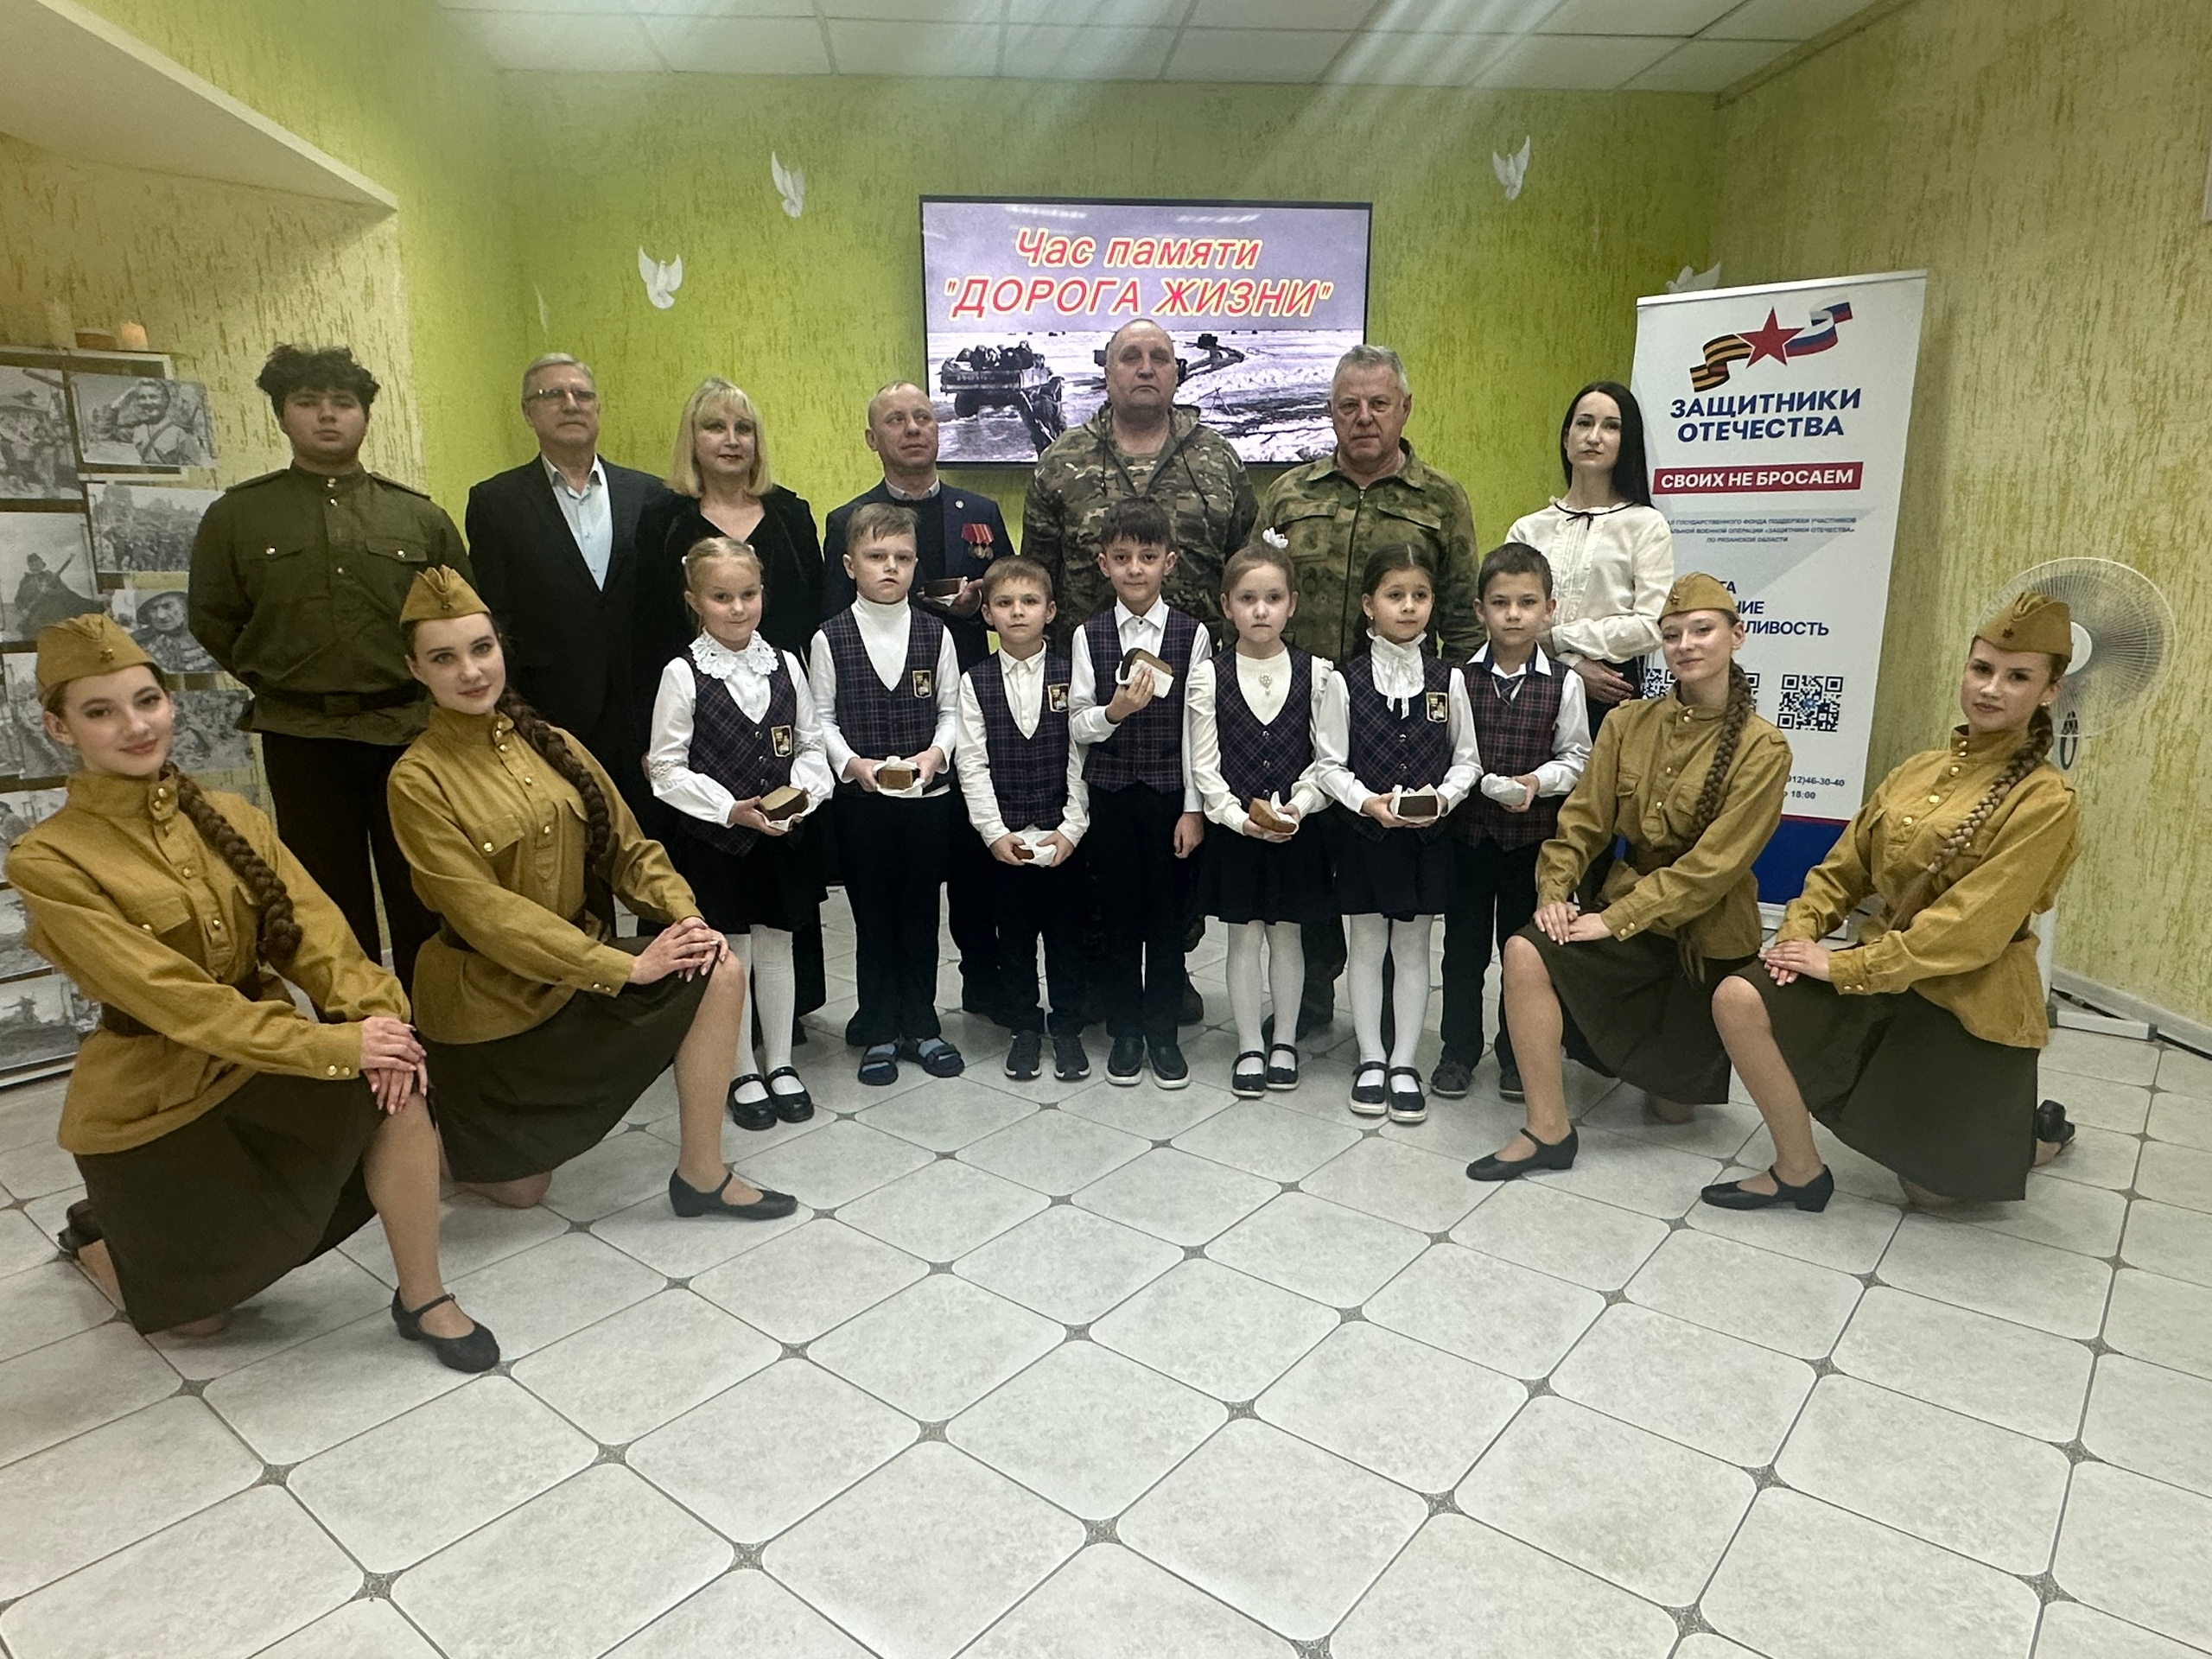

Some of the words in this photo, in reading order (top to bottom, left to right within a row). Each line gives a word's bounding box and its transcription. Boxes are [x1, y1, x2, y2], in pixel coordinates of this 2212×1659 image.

[1016, 228, 1096, 267] Час
[1103, 238, 1262, 269] памяти
[944, 276, 1139, 321] "ДОРОГА
[1150, 277, 1334, 317] ЖИЗНИ"
[1669, 388, 1861, 418] ЗАЩИТНИКИ
[1677, 416, 1844, 442] ОТЕЧЕСТВА
[1661, 473, 1725, 488] СВОИХ
[1728, 472, 1753, 486] НЕ
[1756, 468, 1854, 486] БРОСАЕМ
[1736, 600, 1764, 614] НИЕ
[1742, 620, 1829, 636] ЛИВОСТЬ
